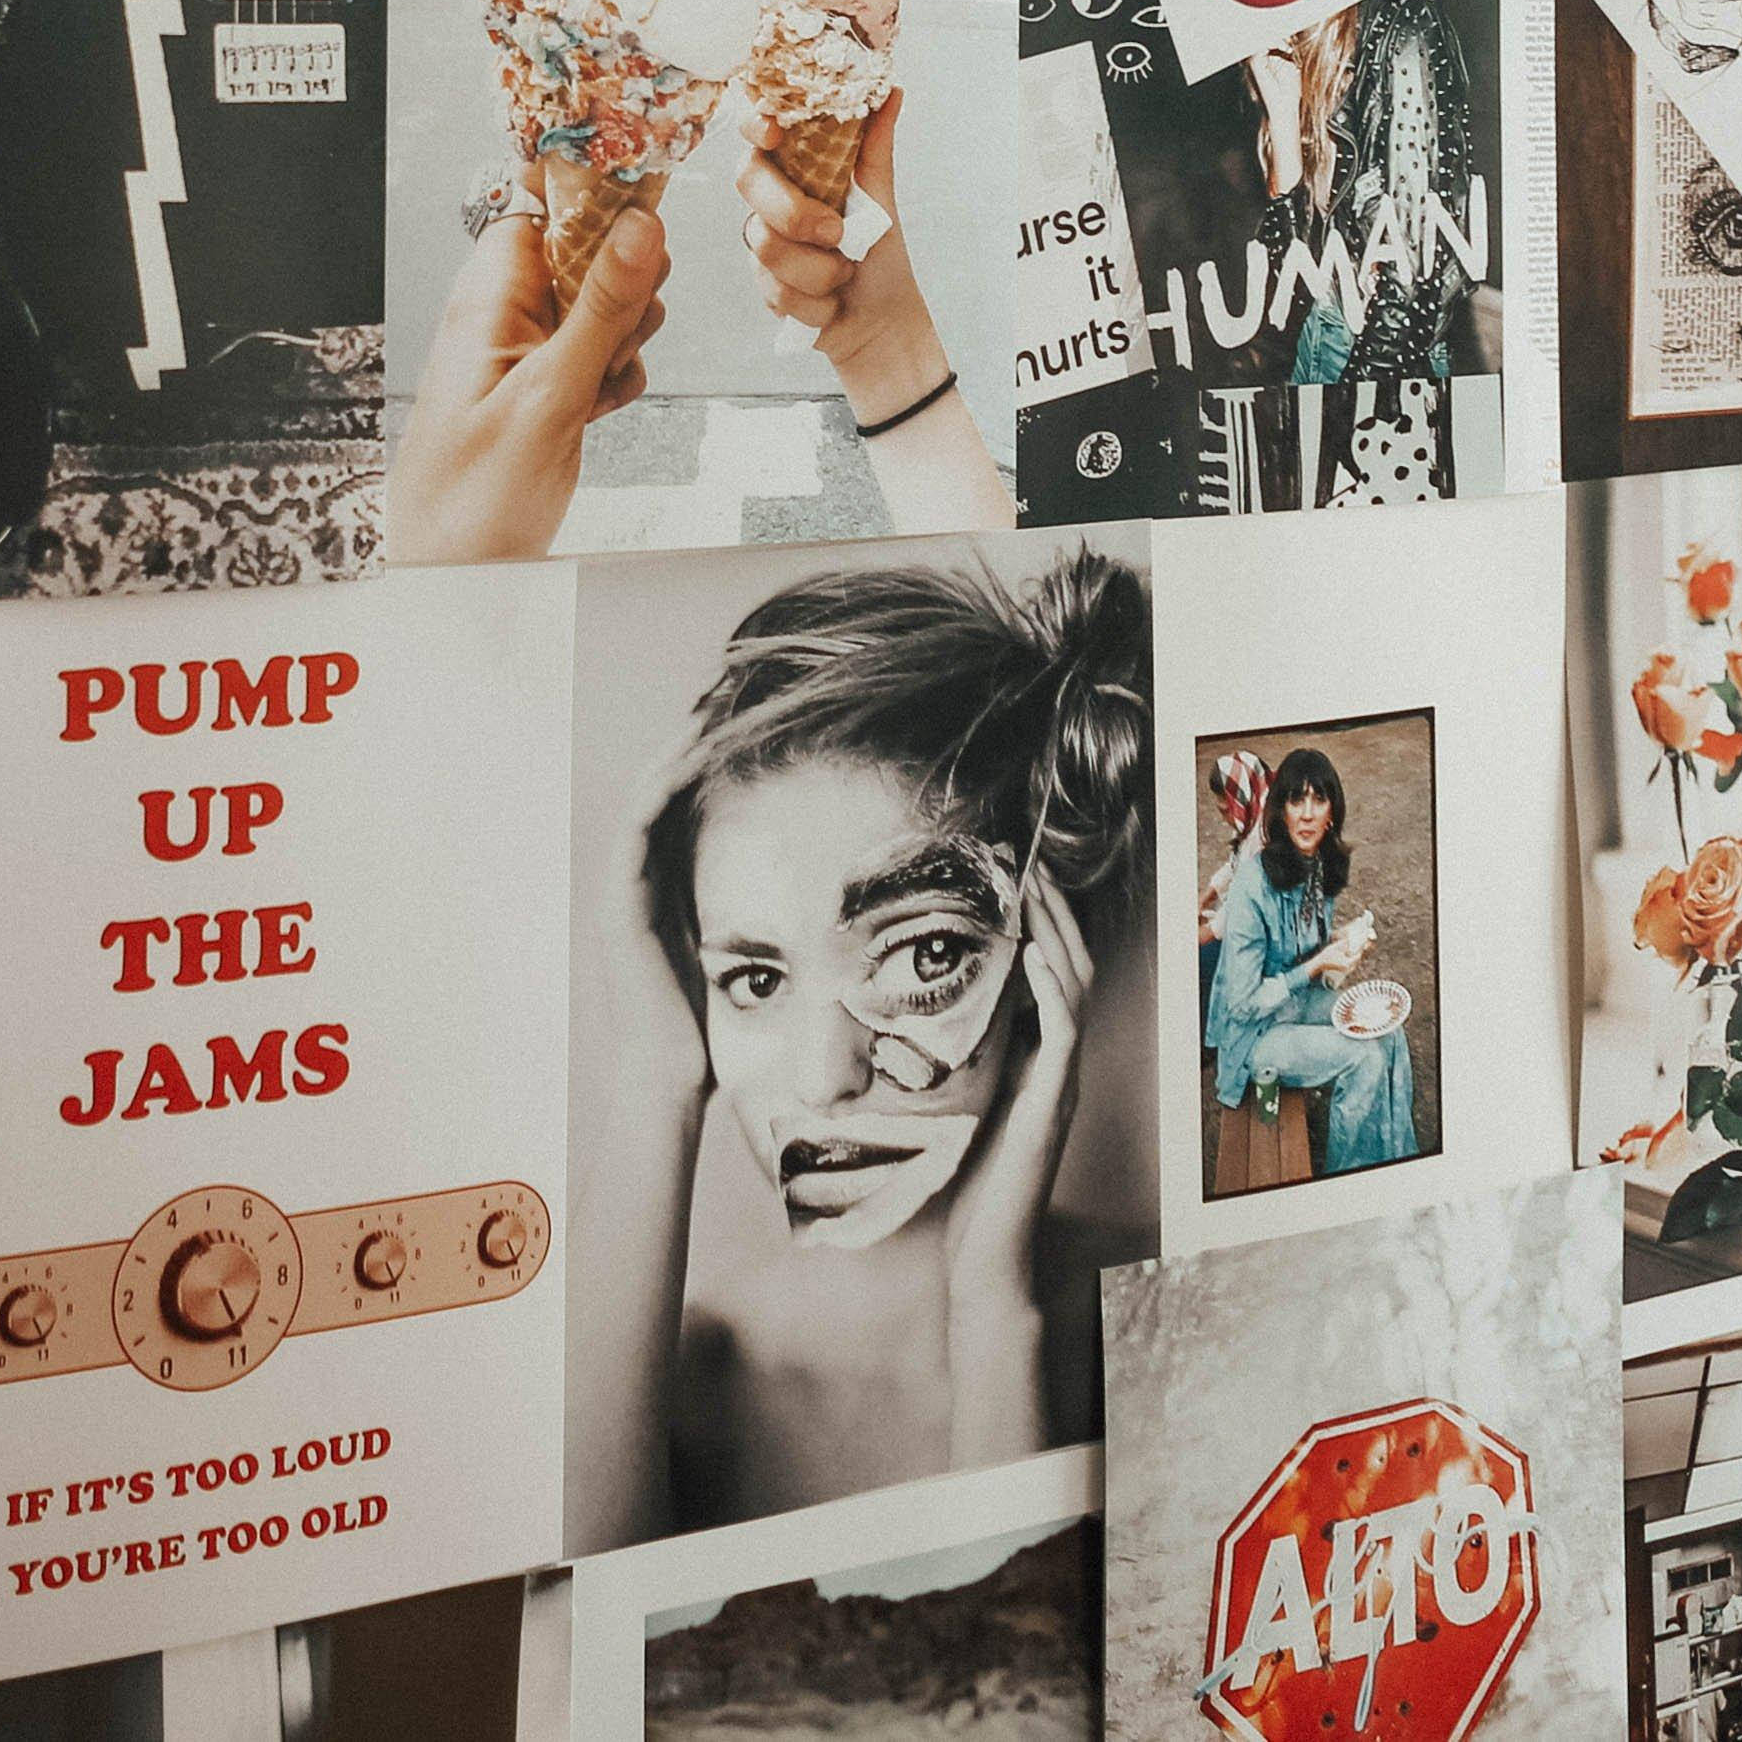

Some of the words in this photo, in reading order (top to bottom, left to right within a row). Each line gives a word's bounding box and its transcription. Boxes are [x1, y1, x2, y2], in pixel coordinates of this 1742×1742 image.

[1084, 255, 1121, 301] it
[1146, 174, 1489, 371] HUMAN
[58, 652, 360, 742] PUMP
[138, 782, 284, 863] UP
[100, 901, 317, 994] THE
[59, 1023, 351, 1127] JAMS
[167, 1209, 178, 1229] 4
[241, 1198, 253, 1220] 6
[277, 1264, 288, 1286] 8
[511, 1269, 521, 1281] 11
[123, 1289, 134, 1312] 2
[390, 1291, 400, 1303] 11
[38, 1348, 49, 1361] 11
[160, 1358, 173, 1379] 0
[228, 1345, 247, 1368] 11
[6, 1488, 54, 1527] IF
[65, 1470, 155, 1516] IT'S
[165, 1453, 259, 1498] TOO
[271, 1427, 392, 1478] LOUD
[8, 1533, 186, 1596] YOU'RE
[197, 1514, 290, 1561] TOO
[301, 1494, 389, 1540] OLD
[1229, 1483, 1511, 1692] ALTO
